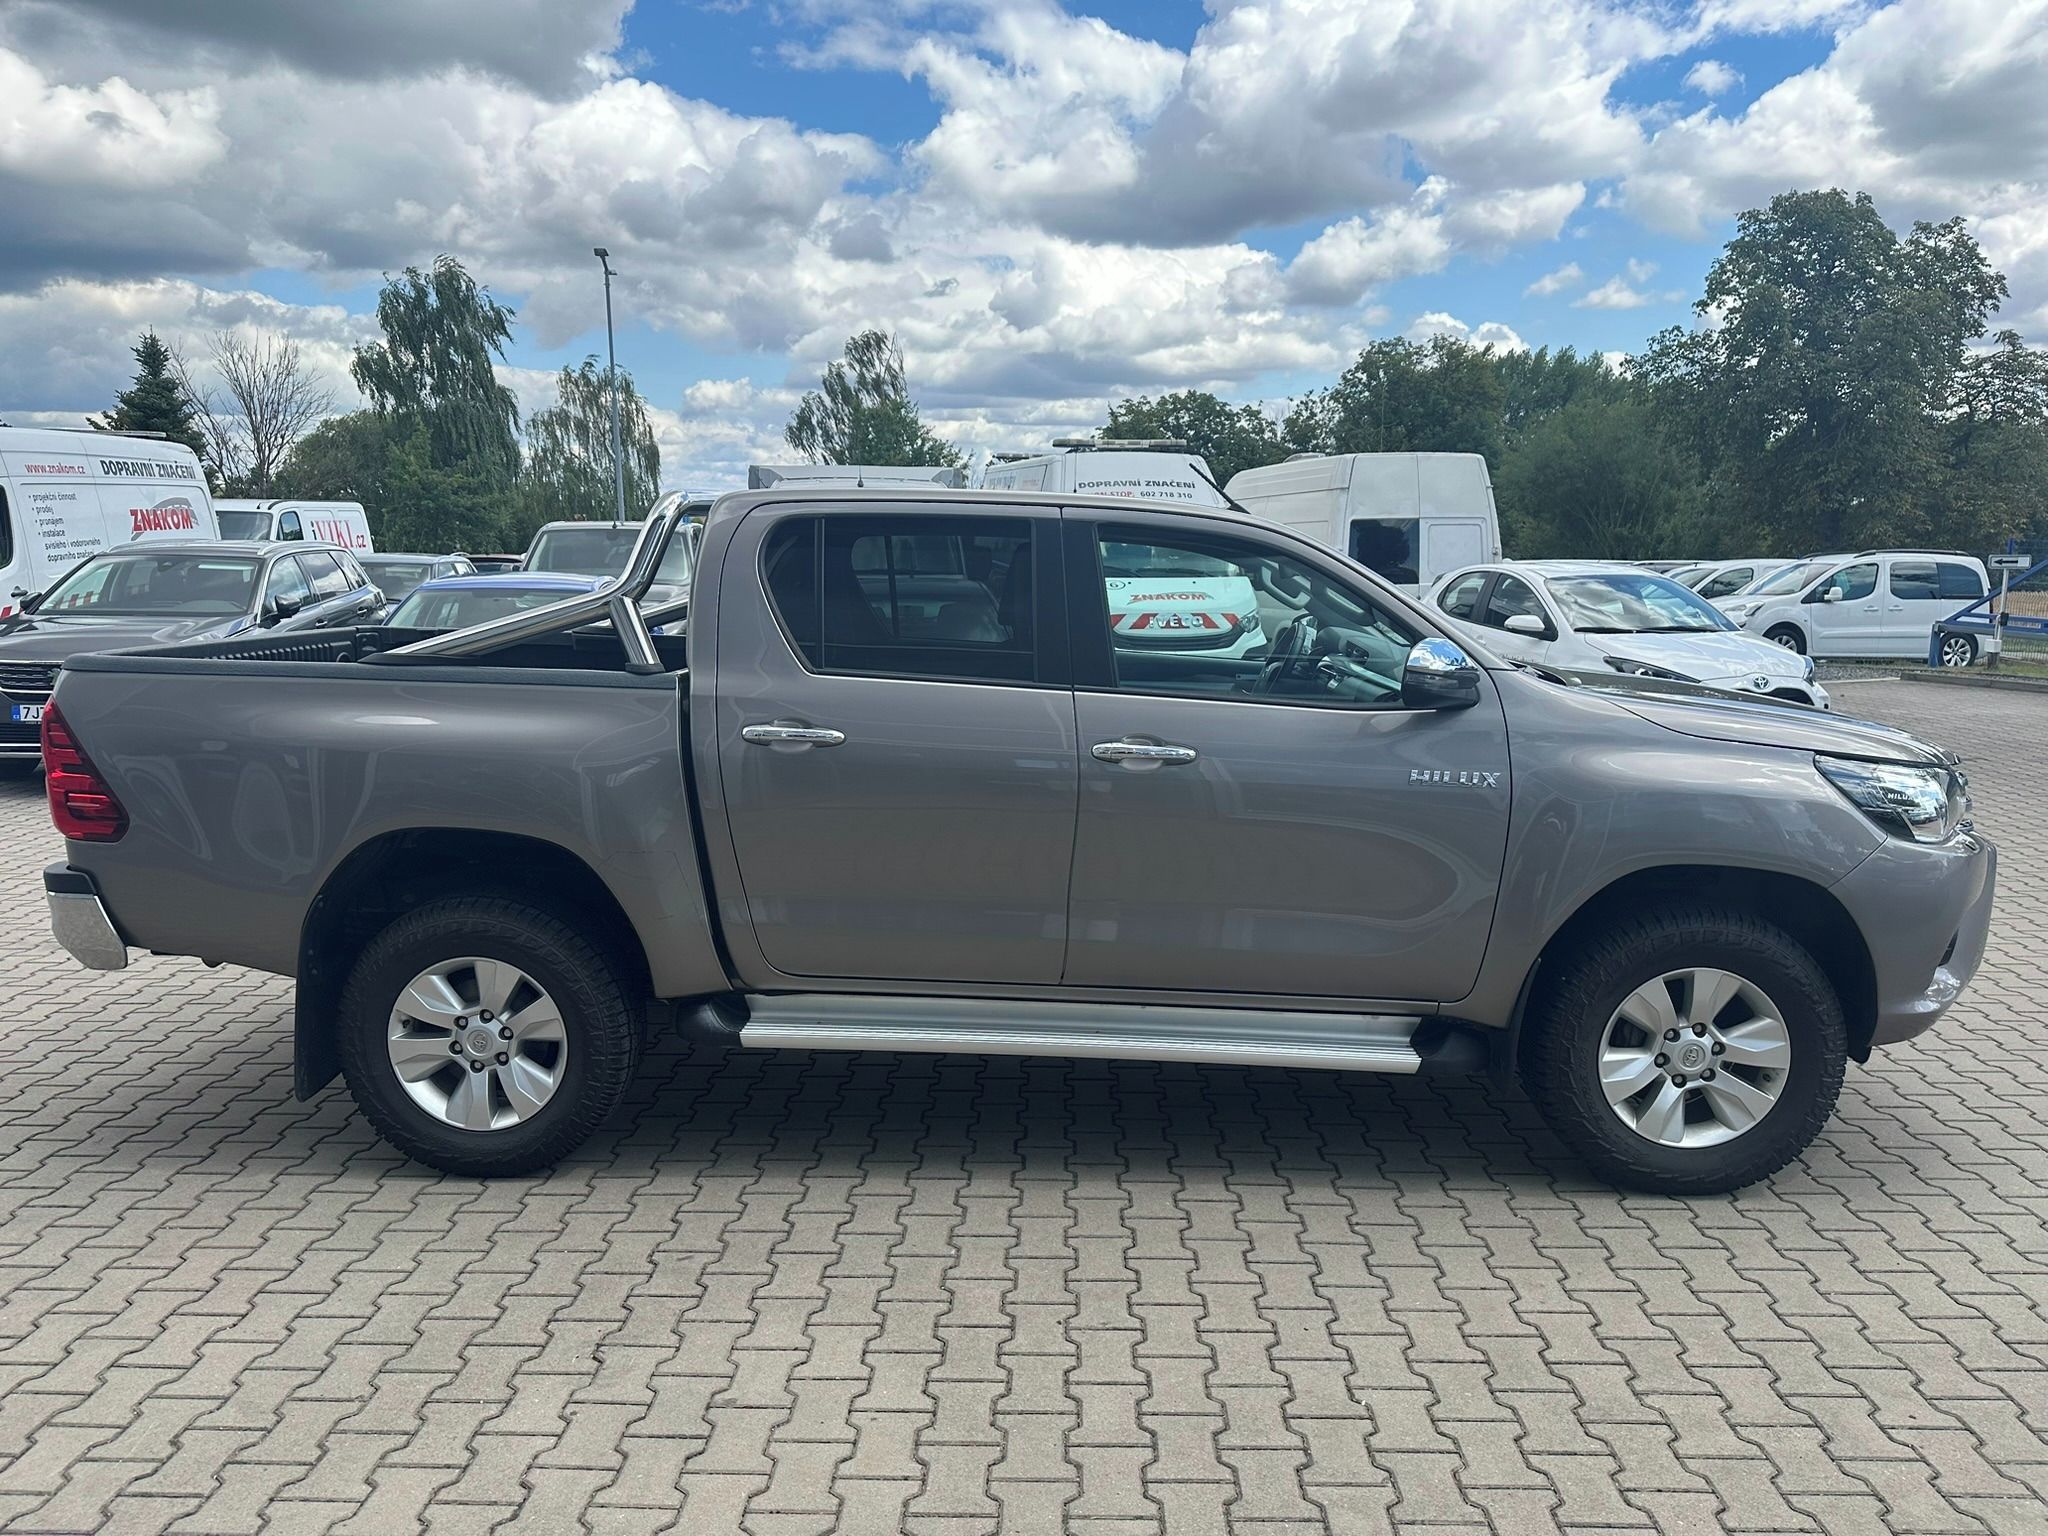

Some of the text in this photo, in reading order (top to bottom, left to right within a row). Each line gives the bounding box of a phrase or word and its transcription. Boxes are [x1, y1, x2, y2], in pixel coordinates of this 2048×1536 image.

[25, 462, 86, 475] www.znakom.cz
[100, 458, 197, 479] DOPRAVNÍ ZNAČENÍ
[1078, 478, 1196, 489] DOPRAVNÍ ZNAČENÍ
[129, 508, 194, 532] ZNAKOM
[1130, 593, 1206, 601] ZNAKOM
[1149, 616, 1204, 629] IVECO
[23, 706, 44, 719] 7J
[1409, 769, 1501, 788] HILUX
